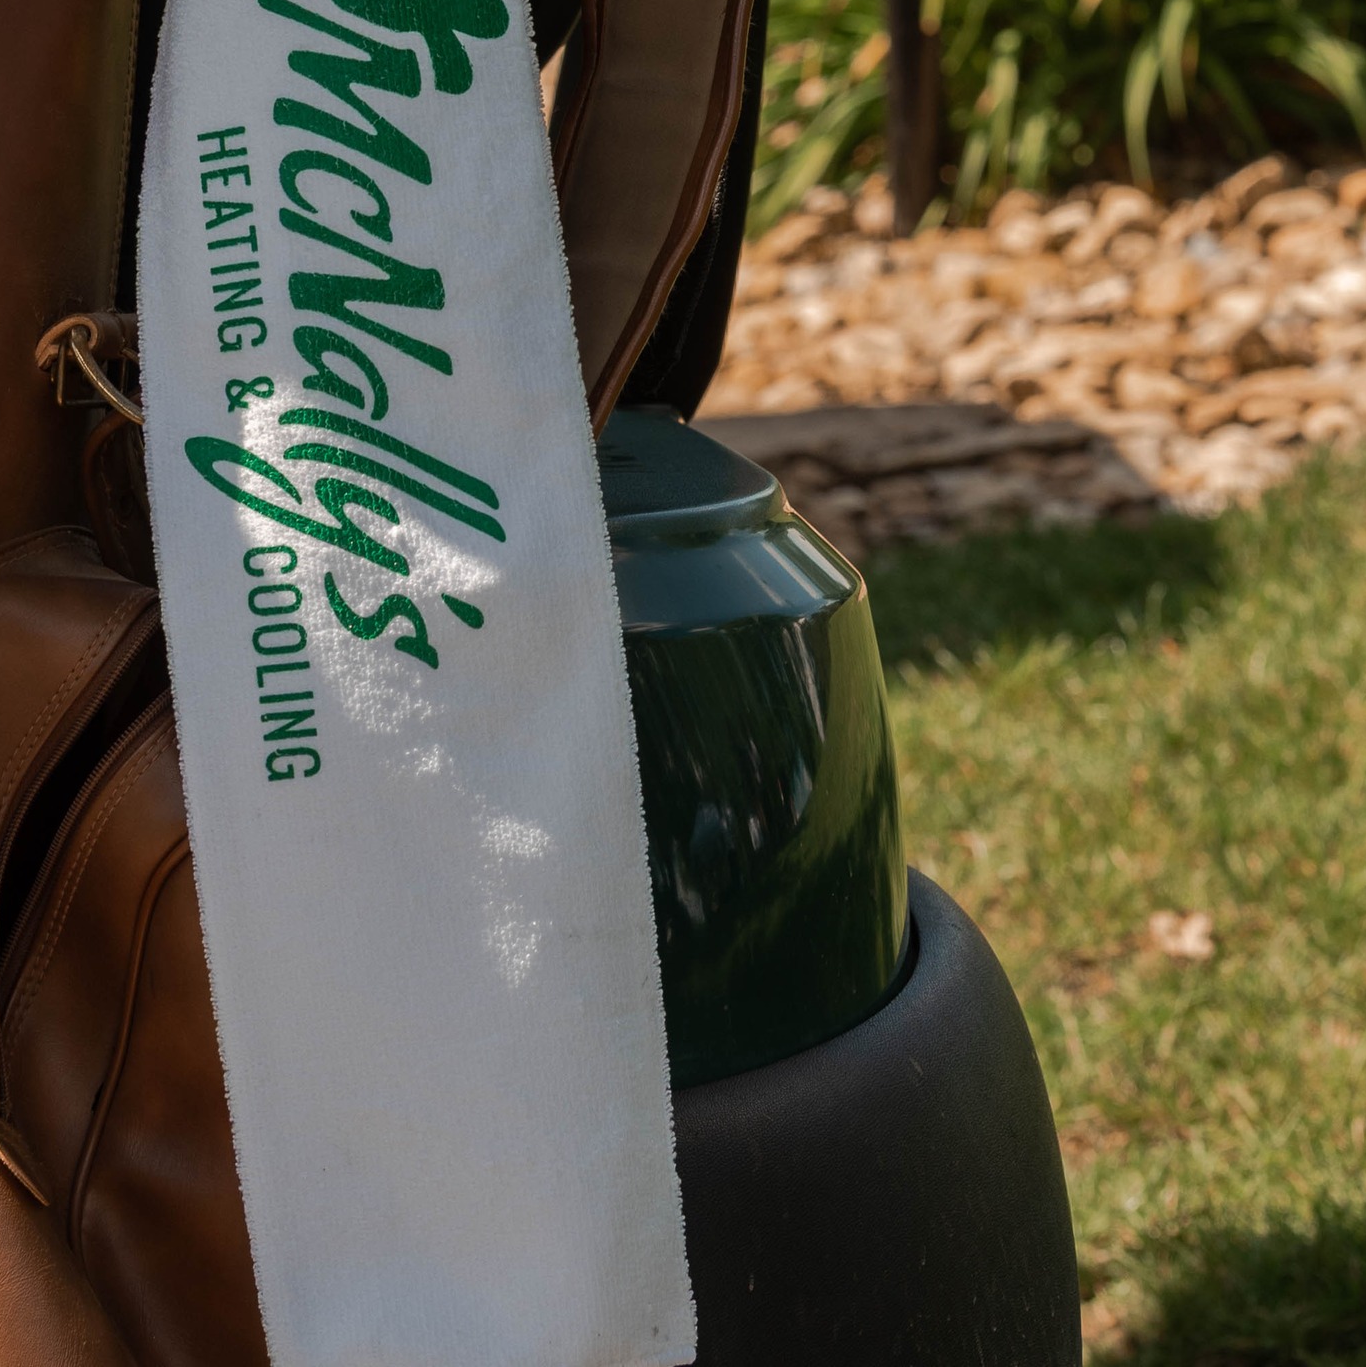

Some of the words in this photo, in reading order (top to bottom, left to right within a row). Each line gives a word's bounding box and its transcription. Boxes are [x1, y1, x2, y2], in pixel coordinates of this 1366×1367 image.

[197, 125, 269, 354] HEATING
[225, 375, 275, 414] &
[243, 545, 320, 782] COOLING
